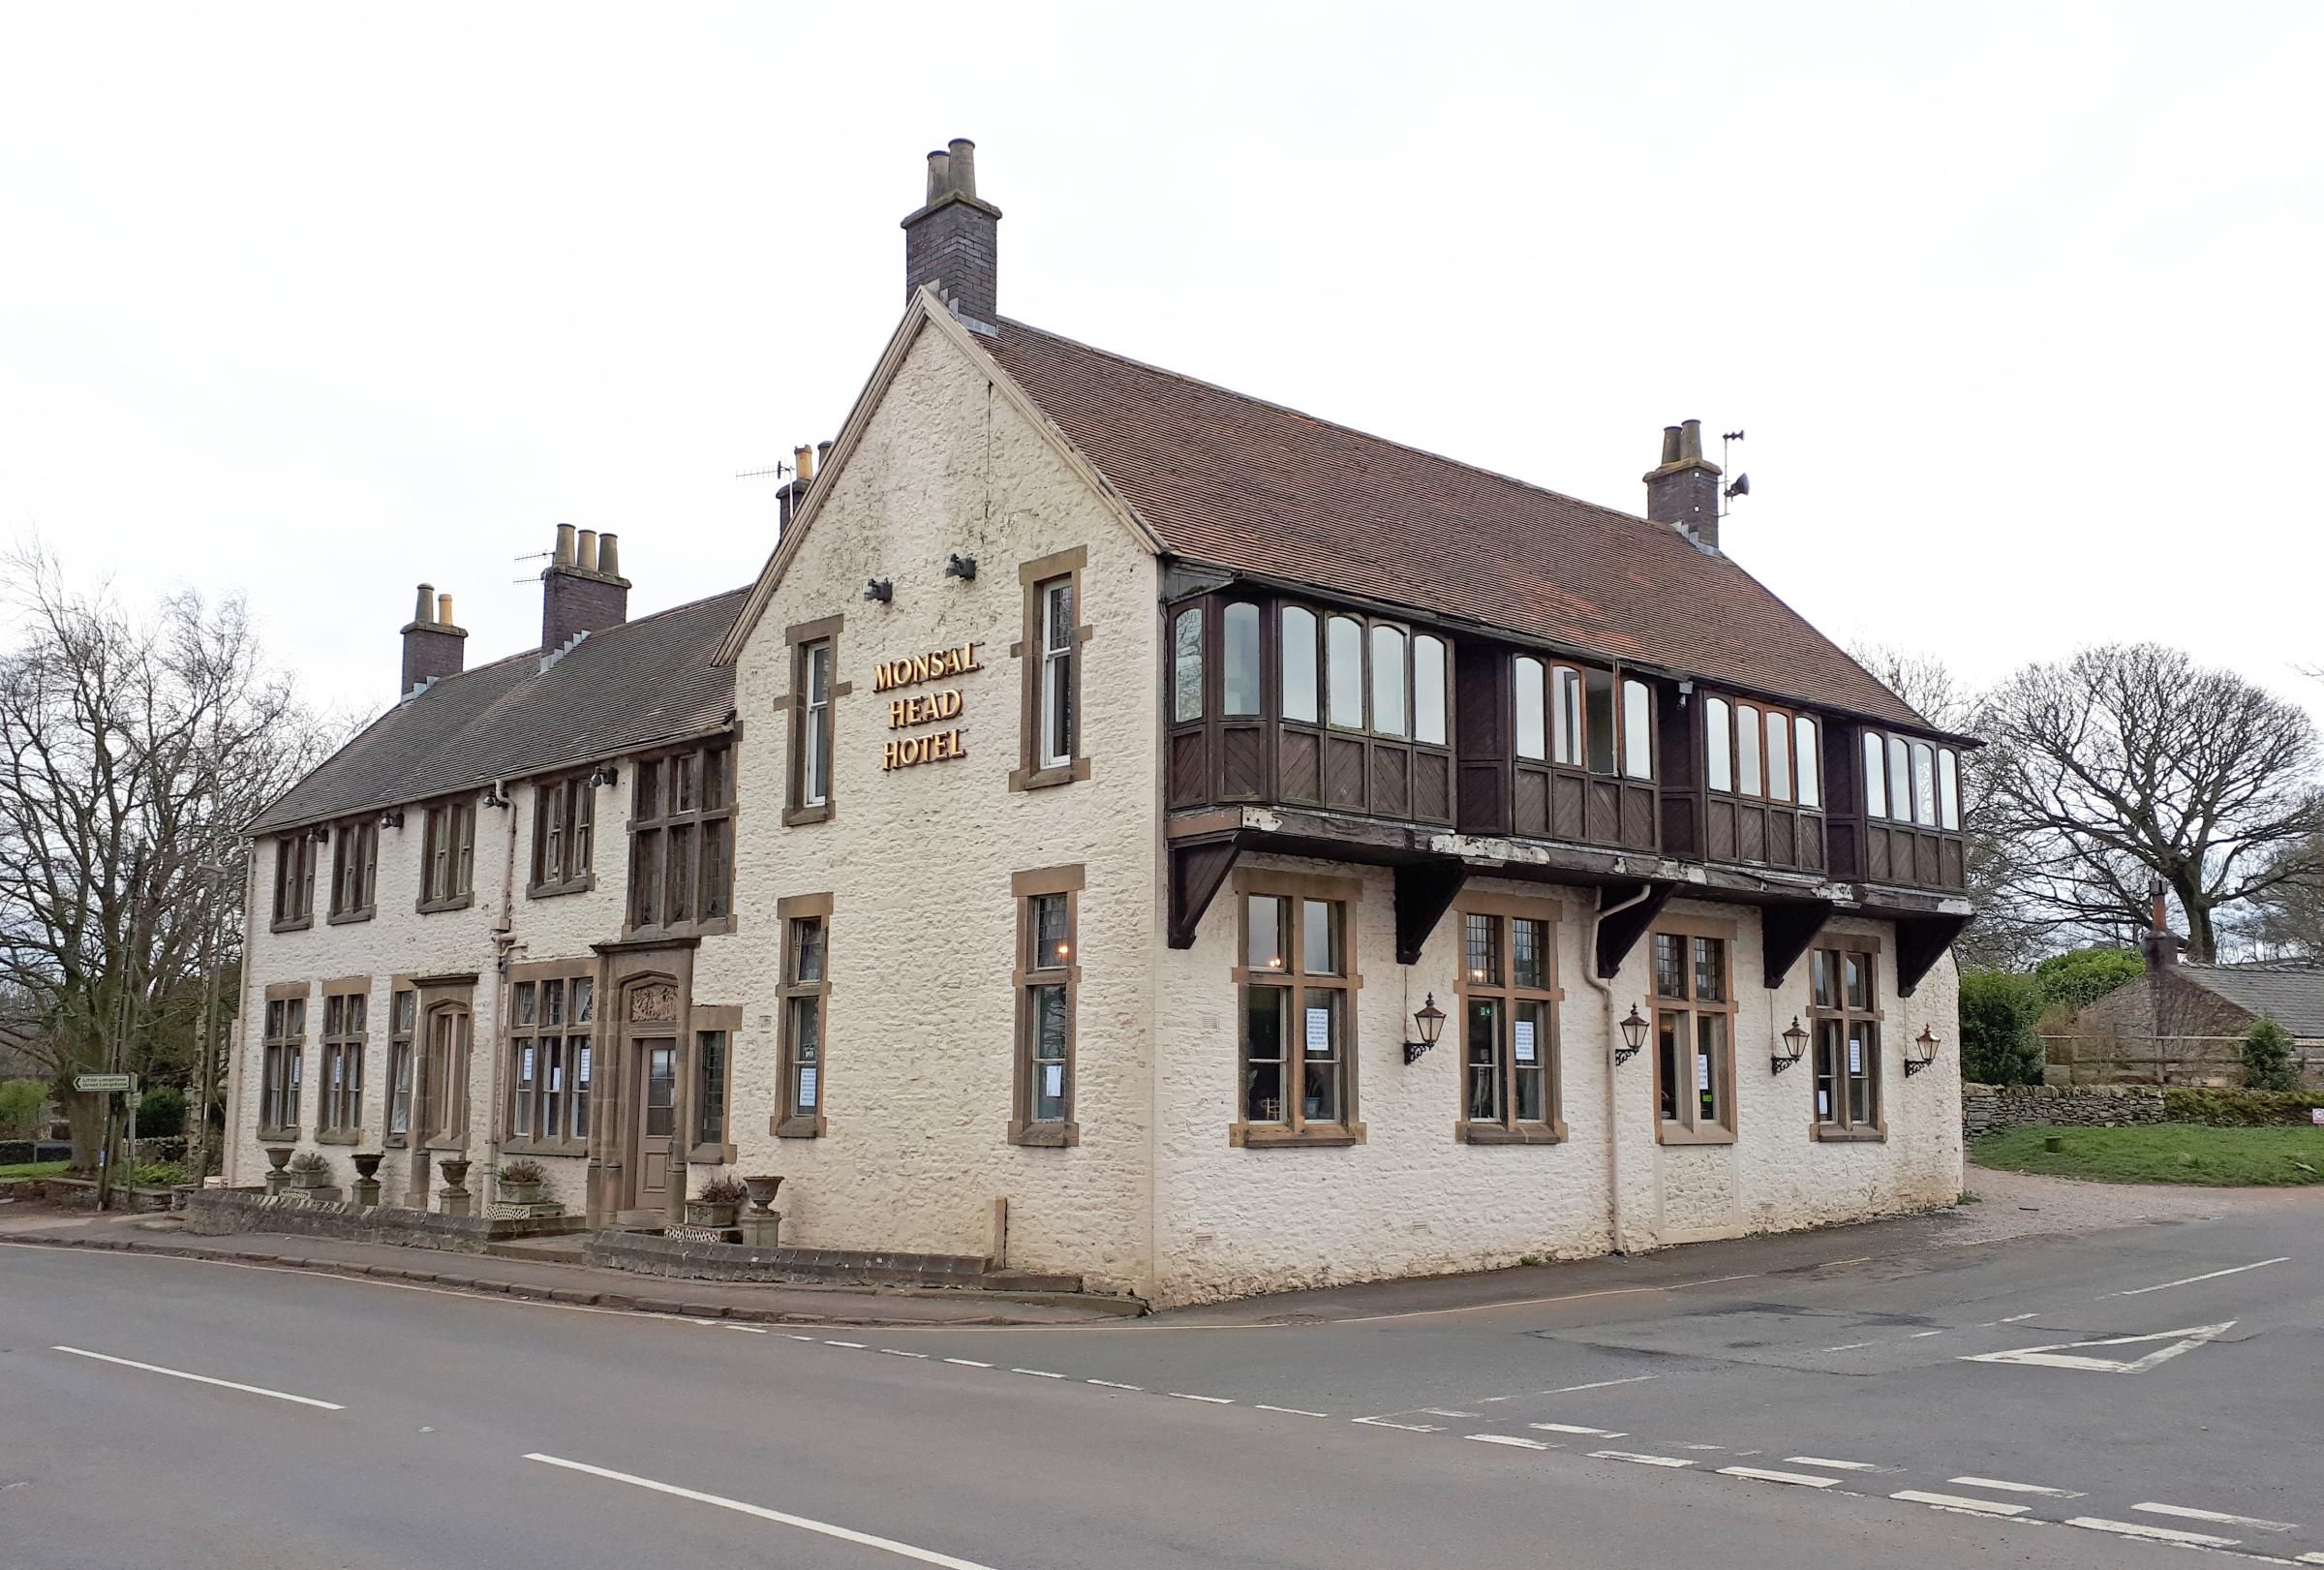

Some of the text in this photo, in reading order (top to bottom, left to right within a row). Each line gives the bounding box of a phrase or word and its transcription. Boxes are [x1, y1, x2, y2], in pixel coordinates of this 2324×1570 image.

[874, 643, 980, 692] MONSAL
[890, 689, 963, 729] HEAD
[883, 728, 966, 771] HOTEL
